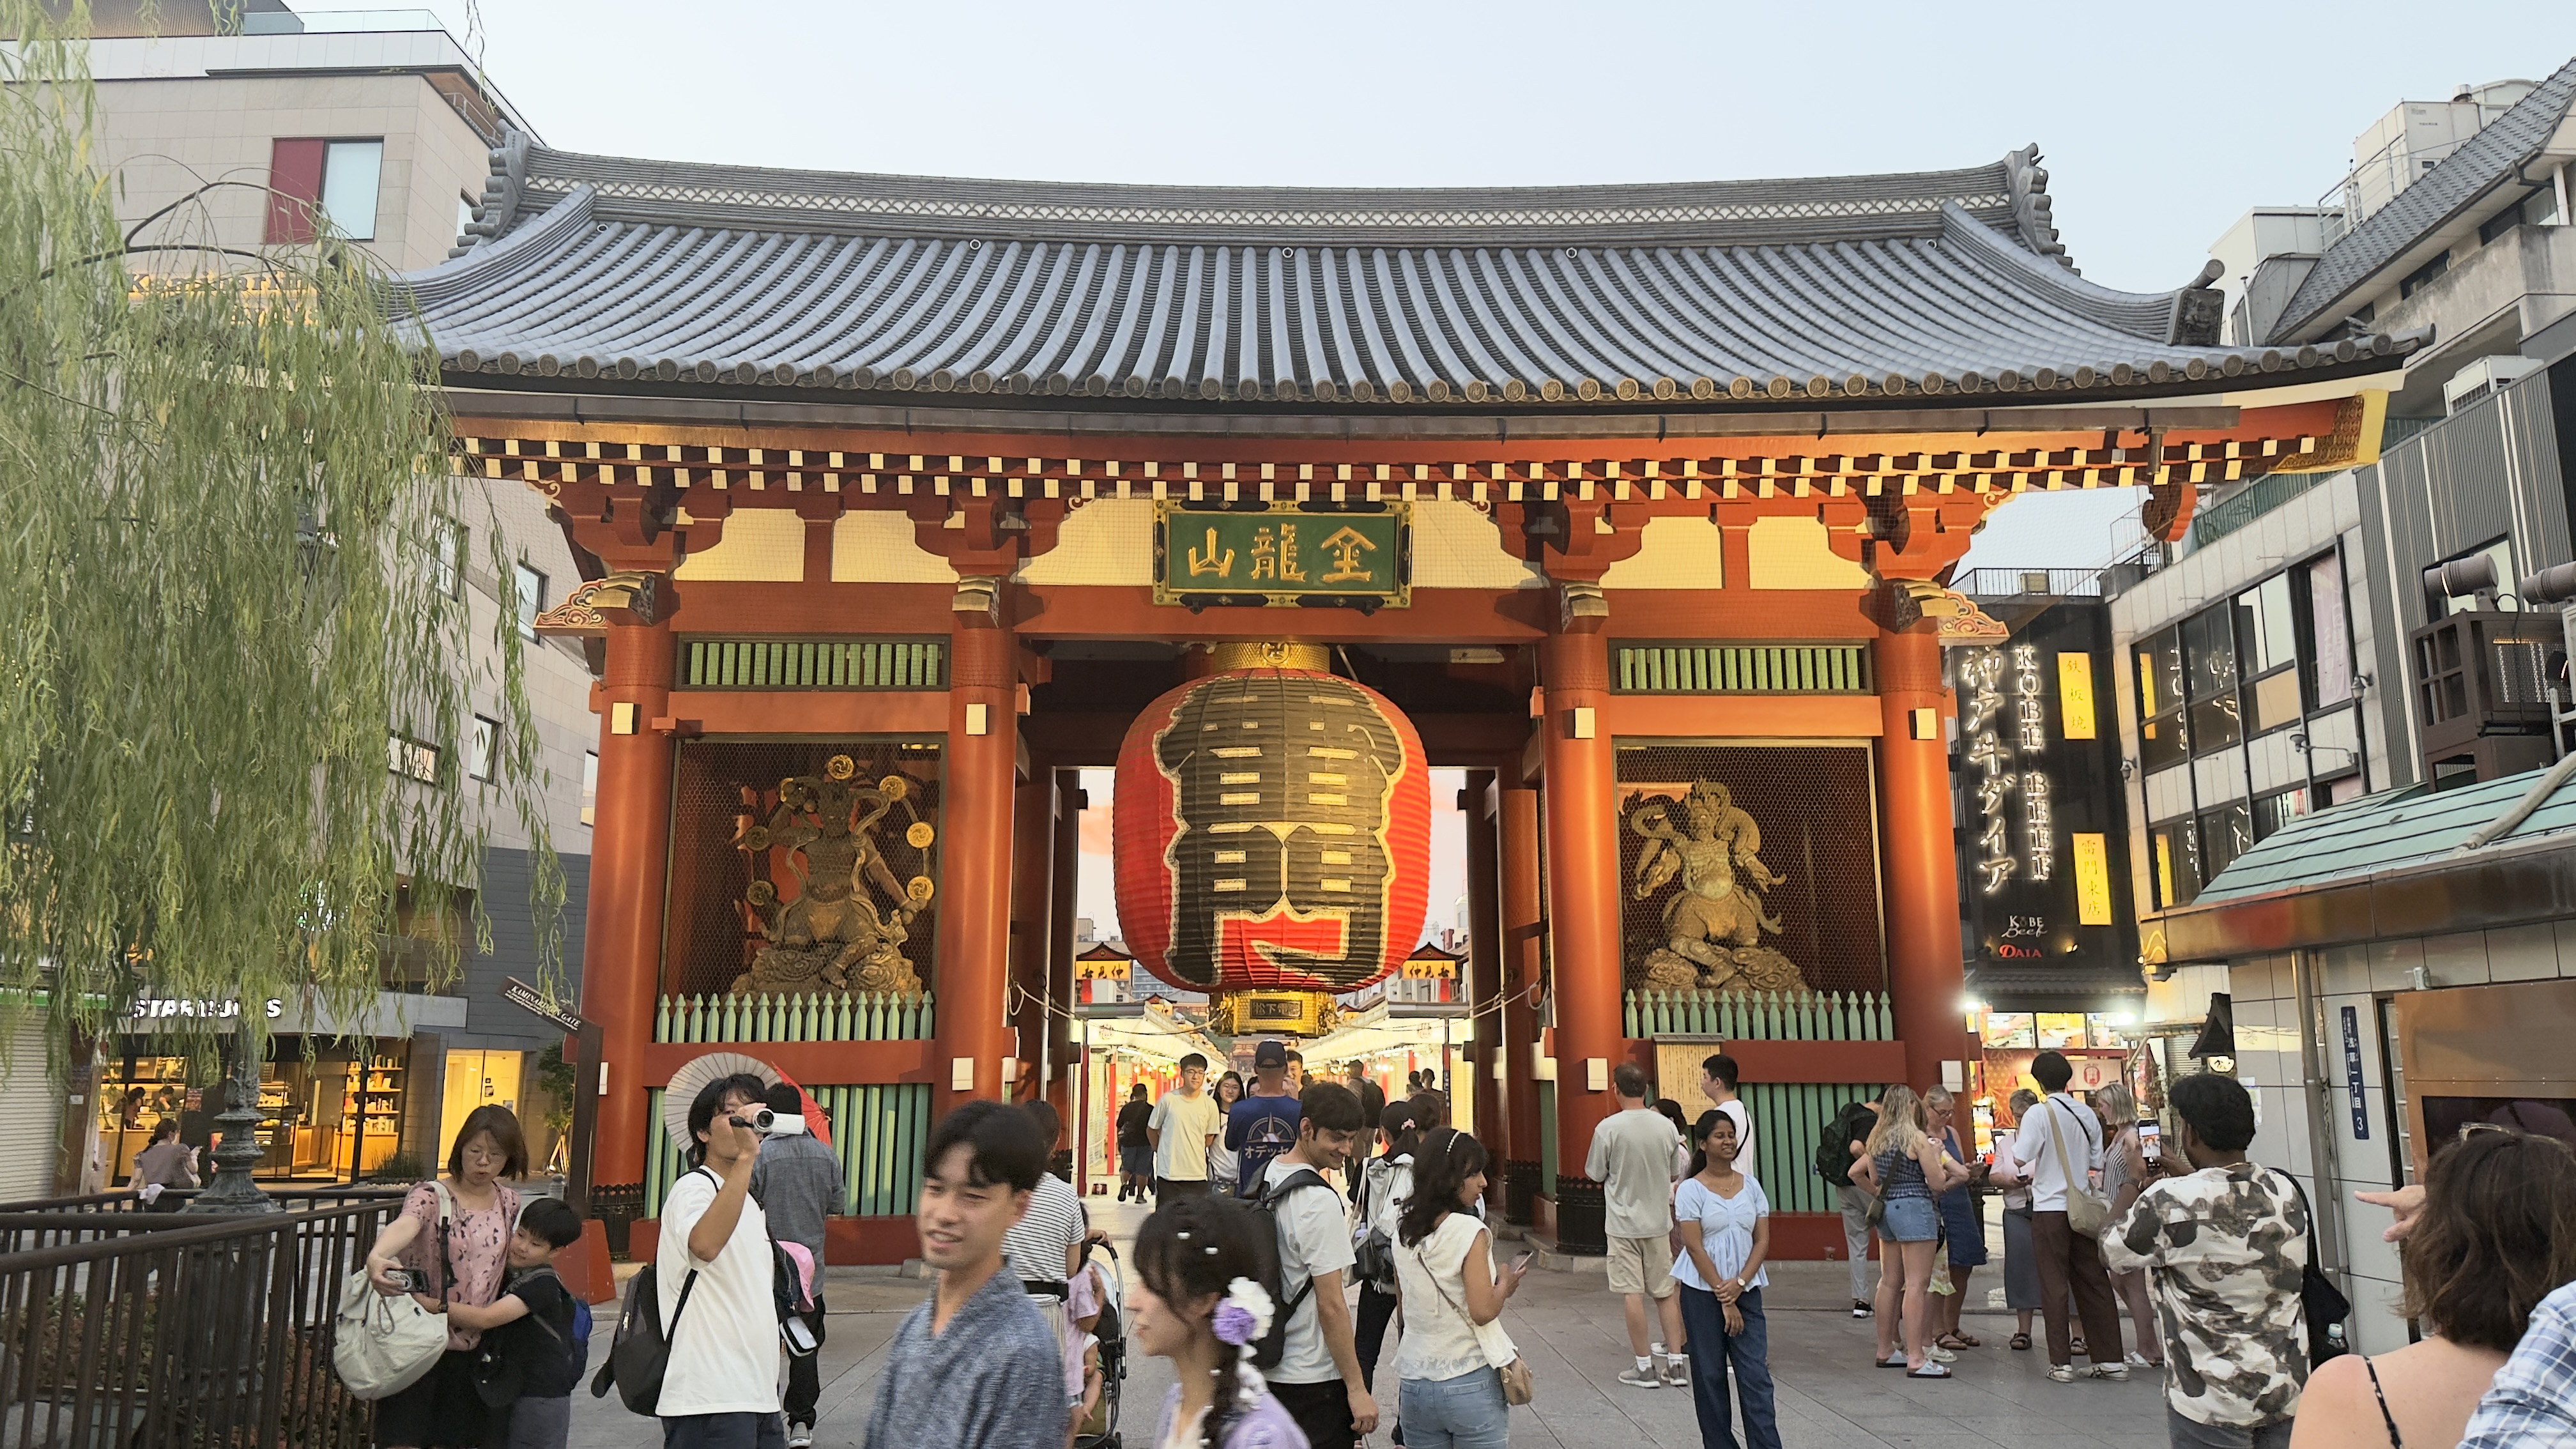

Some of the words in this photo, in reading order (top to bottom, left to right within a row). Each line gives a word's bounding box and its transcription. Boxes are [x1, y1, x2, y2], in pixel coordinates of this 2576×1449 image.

[2014, 645, 2043, 750] KOBE
[1961, 645, 2016, 892] 神戸牛ダイア
[1154, 676, 1406, 988] 雷門
[2024, 772, 2051, 880] BEEF
[2082, 839, 2101, 917] 雷門東店
[2000, 924, 2048, 939] Beef
[2009, 915, 2043, 929] KOBE
[510, 985, 563, 1017] KAMINARIMN
[560, 1013, 582, 1028] GATE
[1245, 1144, 1289, 1160] オデッセ
[2356, 1116, 2364, 1131] 3
